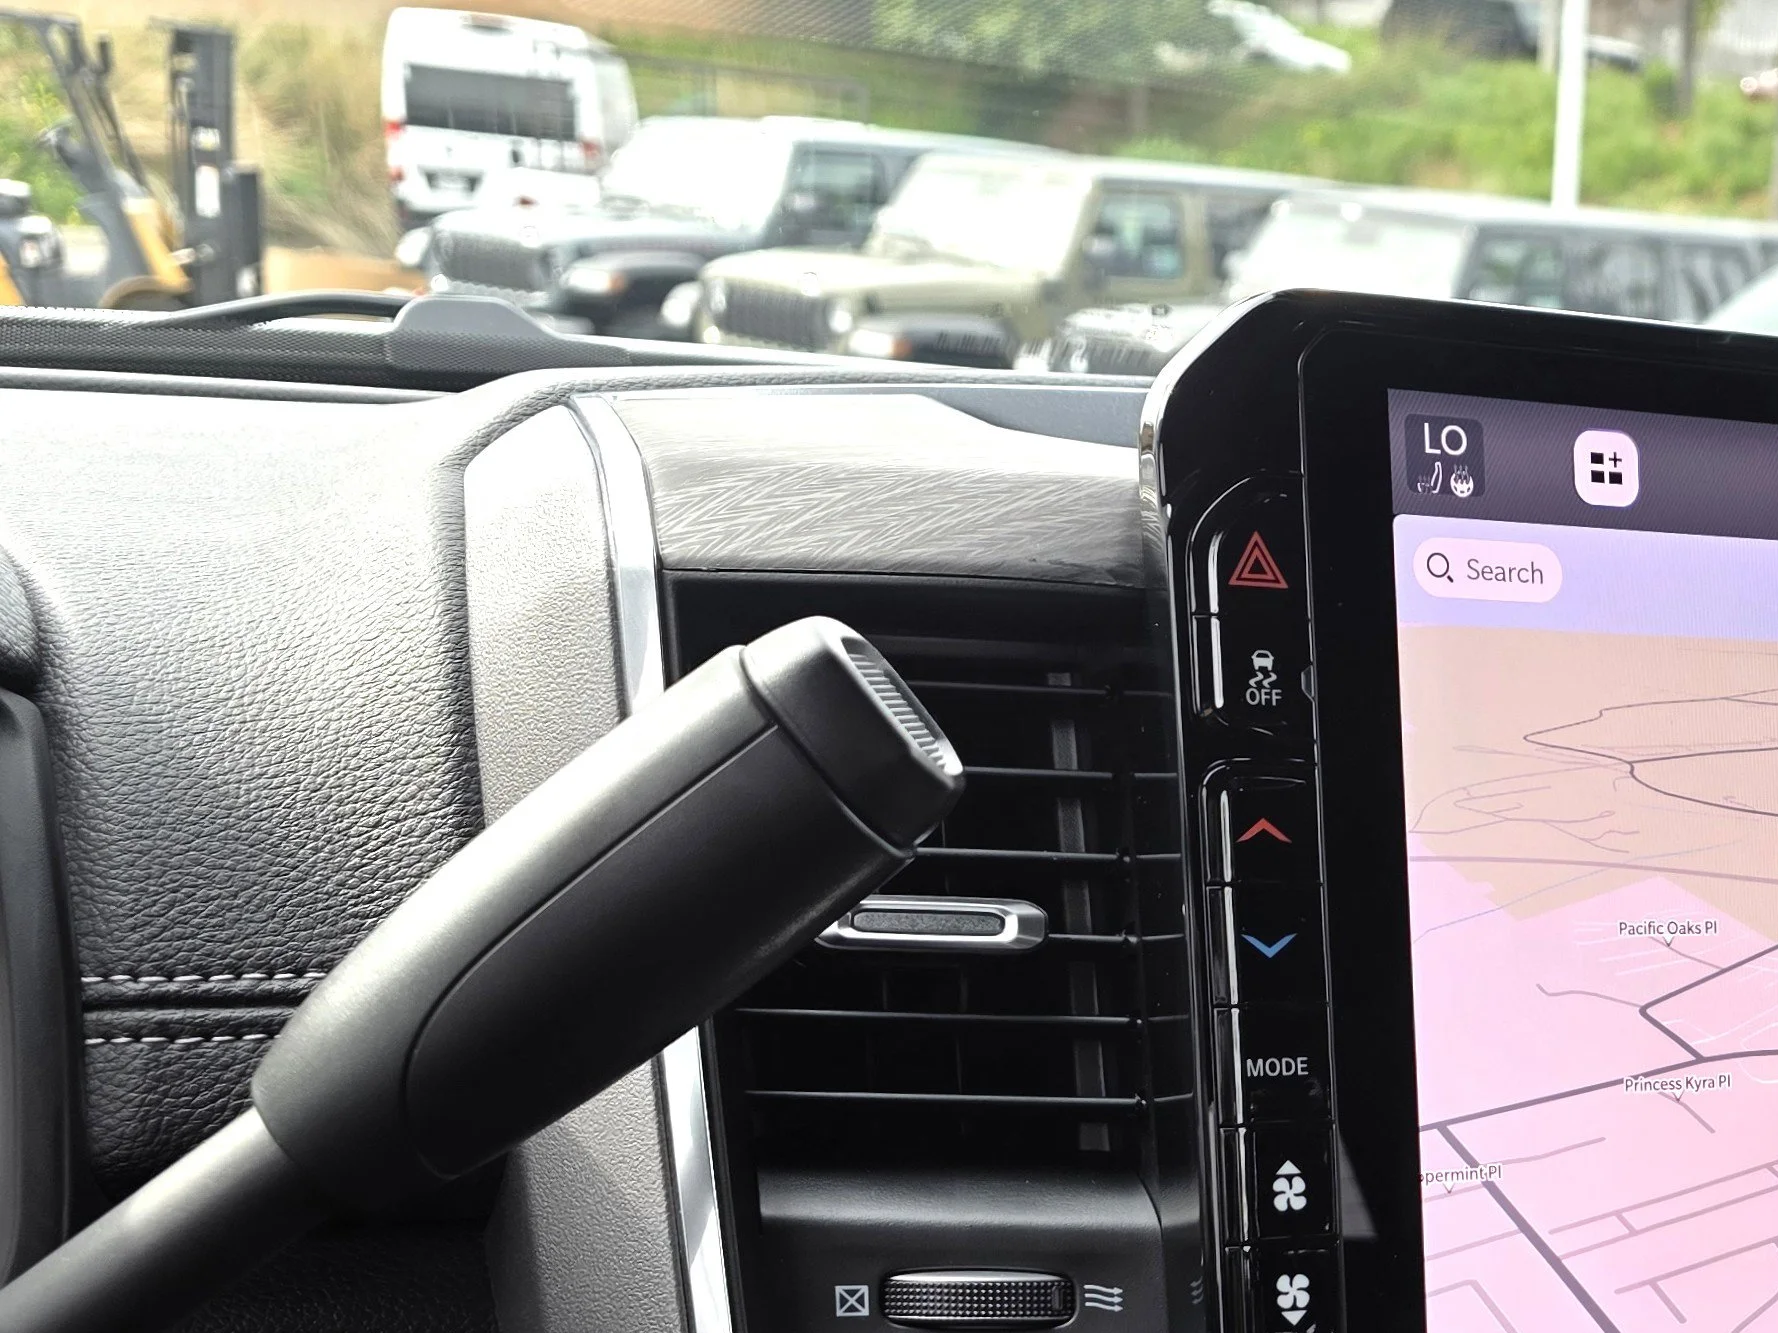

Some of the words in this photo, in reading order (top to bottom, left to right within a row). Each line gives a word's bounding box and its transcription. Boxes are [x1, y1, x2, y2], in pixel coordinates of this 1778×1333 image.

[1424, 423, 1467, 456] LO
[1466, 558, 1544, 586] Search
[1246, 688, 1282, 706] OFF
[1619, 920, 1663, 936] Pacific
[1667, 921, 1699, 935] Oaks
[1705, 920, 1717, 934] Pl
[1247, 1057, 1309, 1077] MODE
[1625, 1075, 1682, 1091] Princess
[1686, 1074, 1714, 1094] Kyra
[1719, 1073, 1731, 1089] Pl
[1489, 1164, 1502, 1179] Pl
